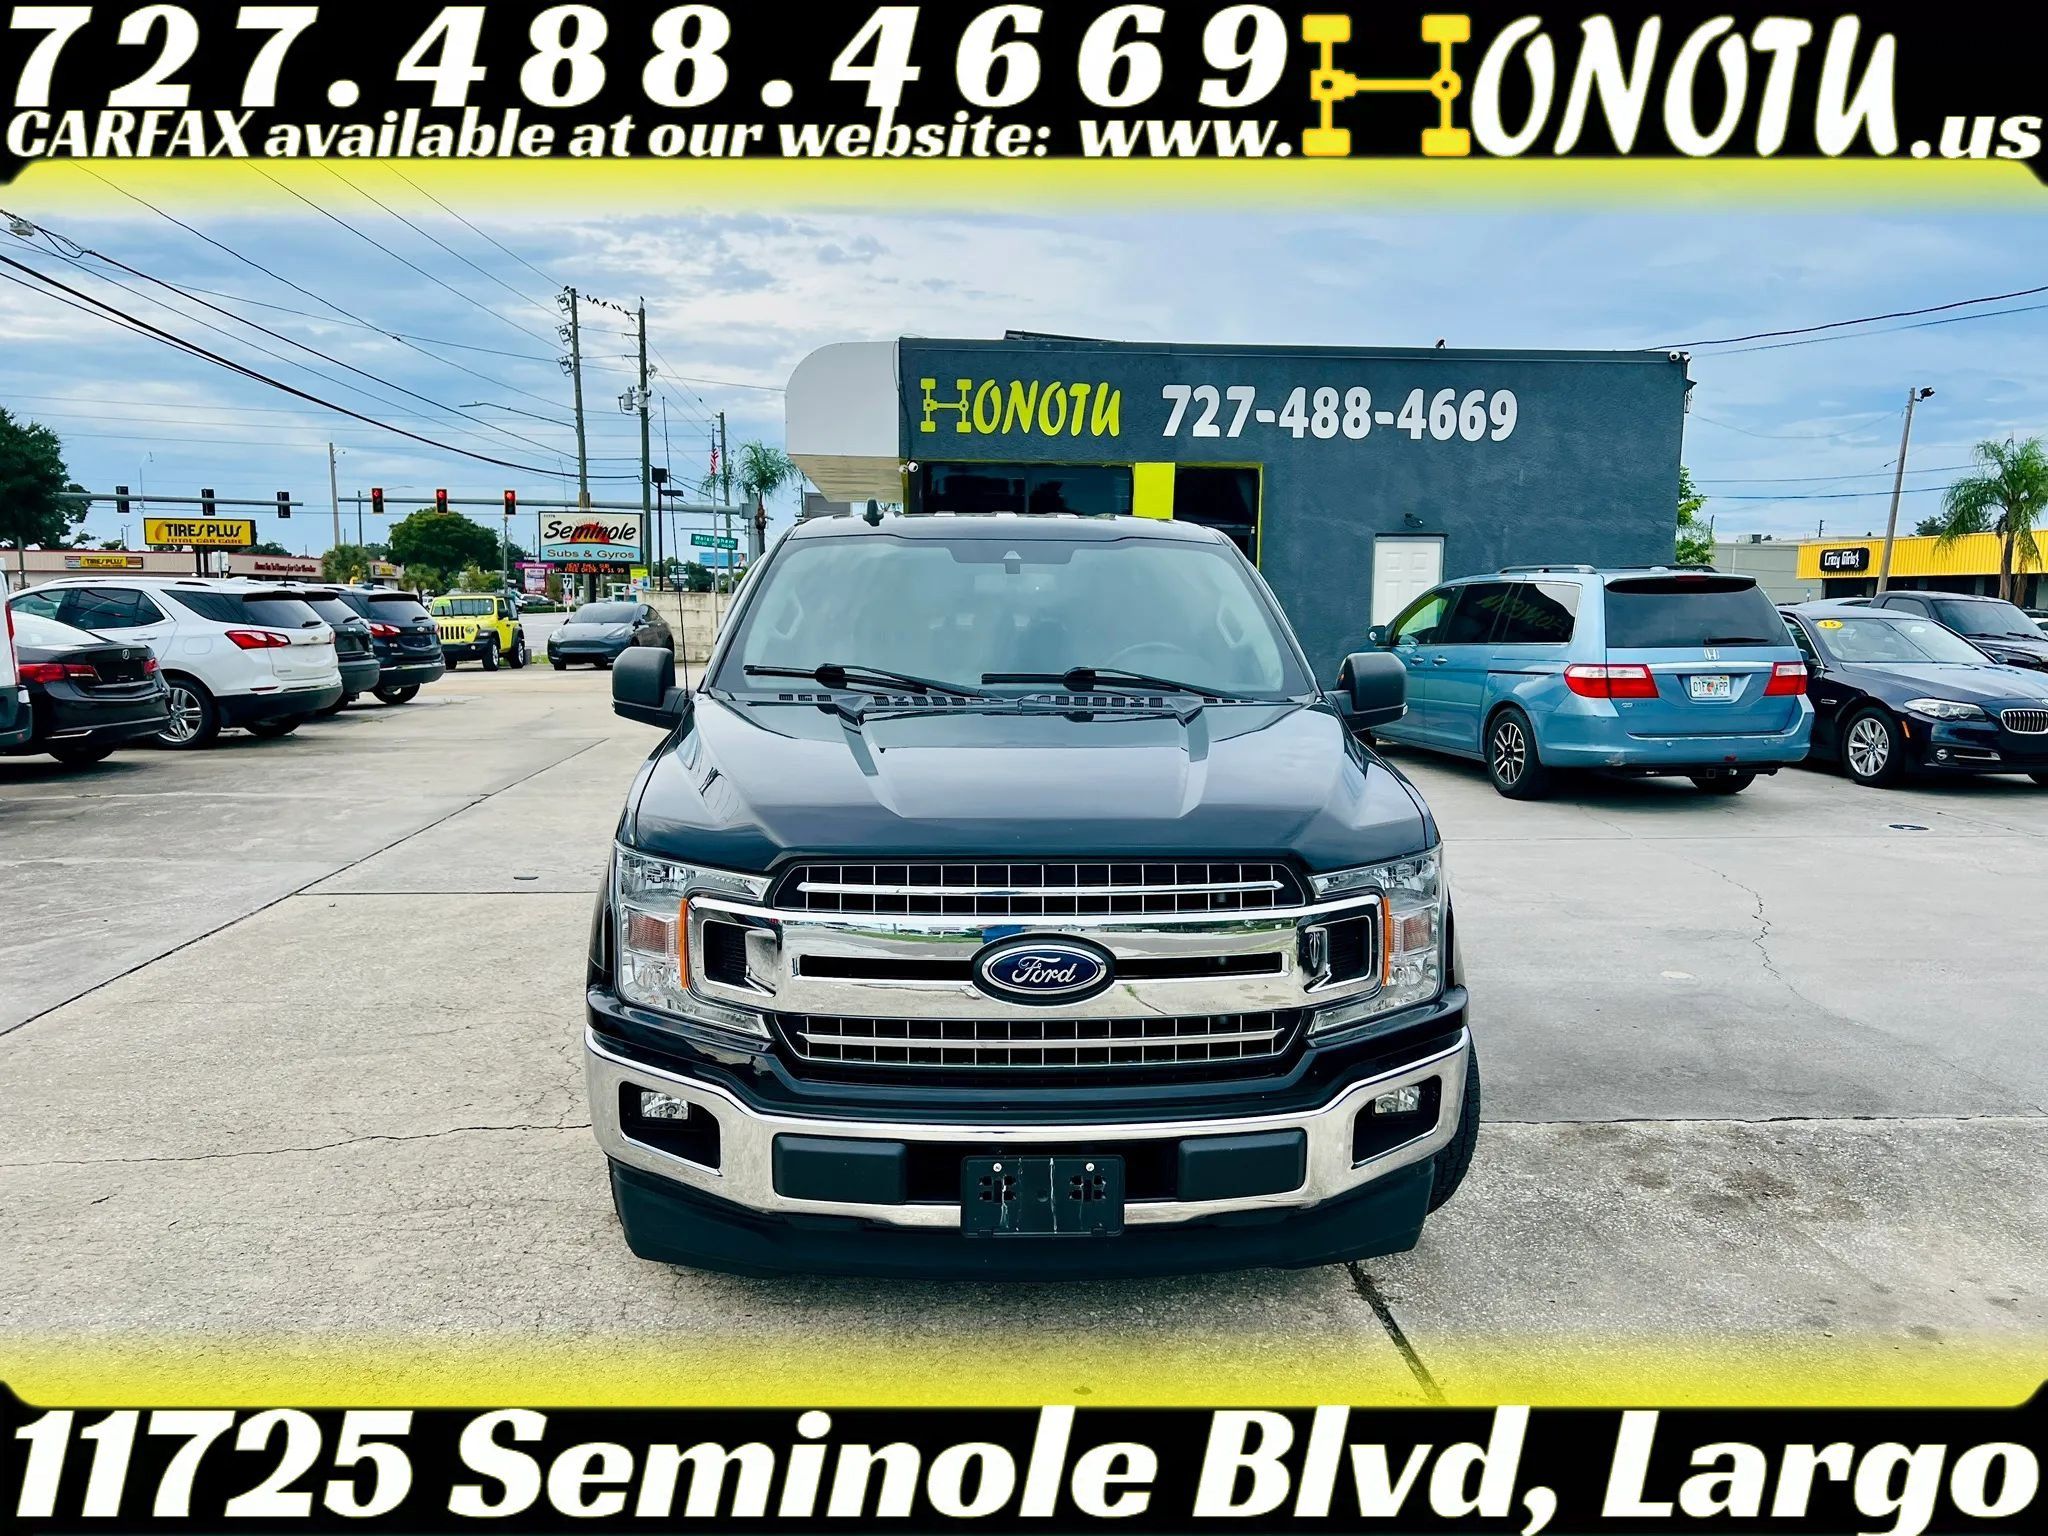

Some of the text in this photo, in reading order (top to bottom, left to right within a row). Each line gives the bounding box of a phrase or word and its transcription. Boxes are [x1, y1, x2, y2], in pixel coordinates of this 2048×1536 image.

[920, 378, 1121, 437] HONOTU
[1162, 384, 1518, 442] 727-488-4669
[165, 523, 242, 538] TIRES PLUS
[544, 520, 637, 540] Seminole
[547, 549, 635, 560] Subs & Gyros
[1011, 956, 1077, 983] Ford
